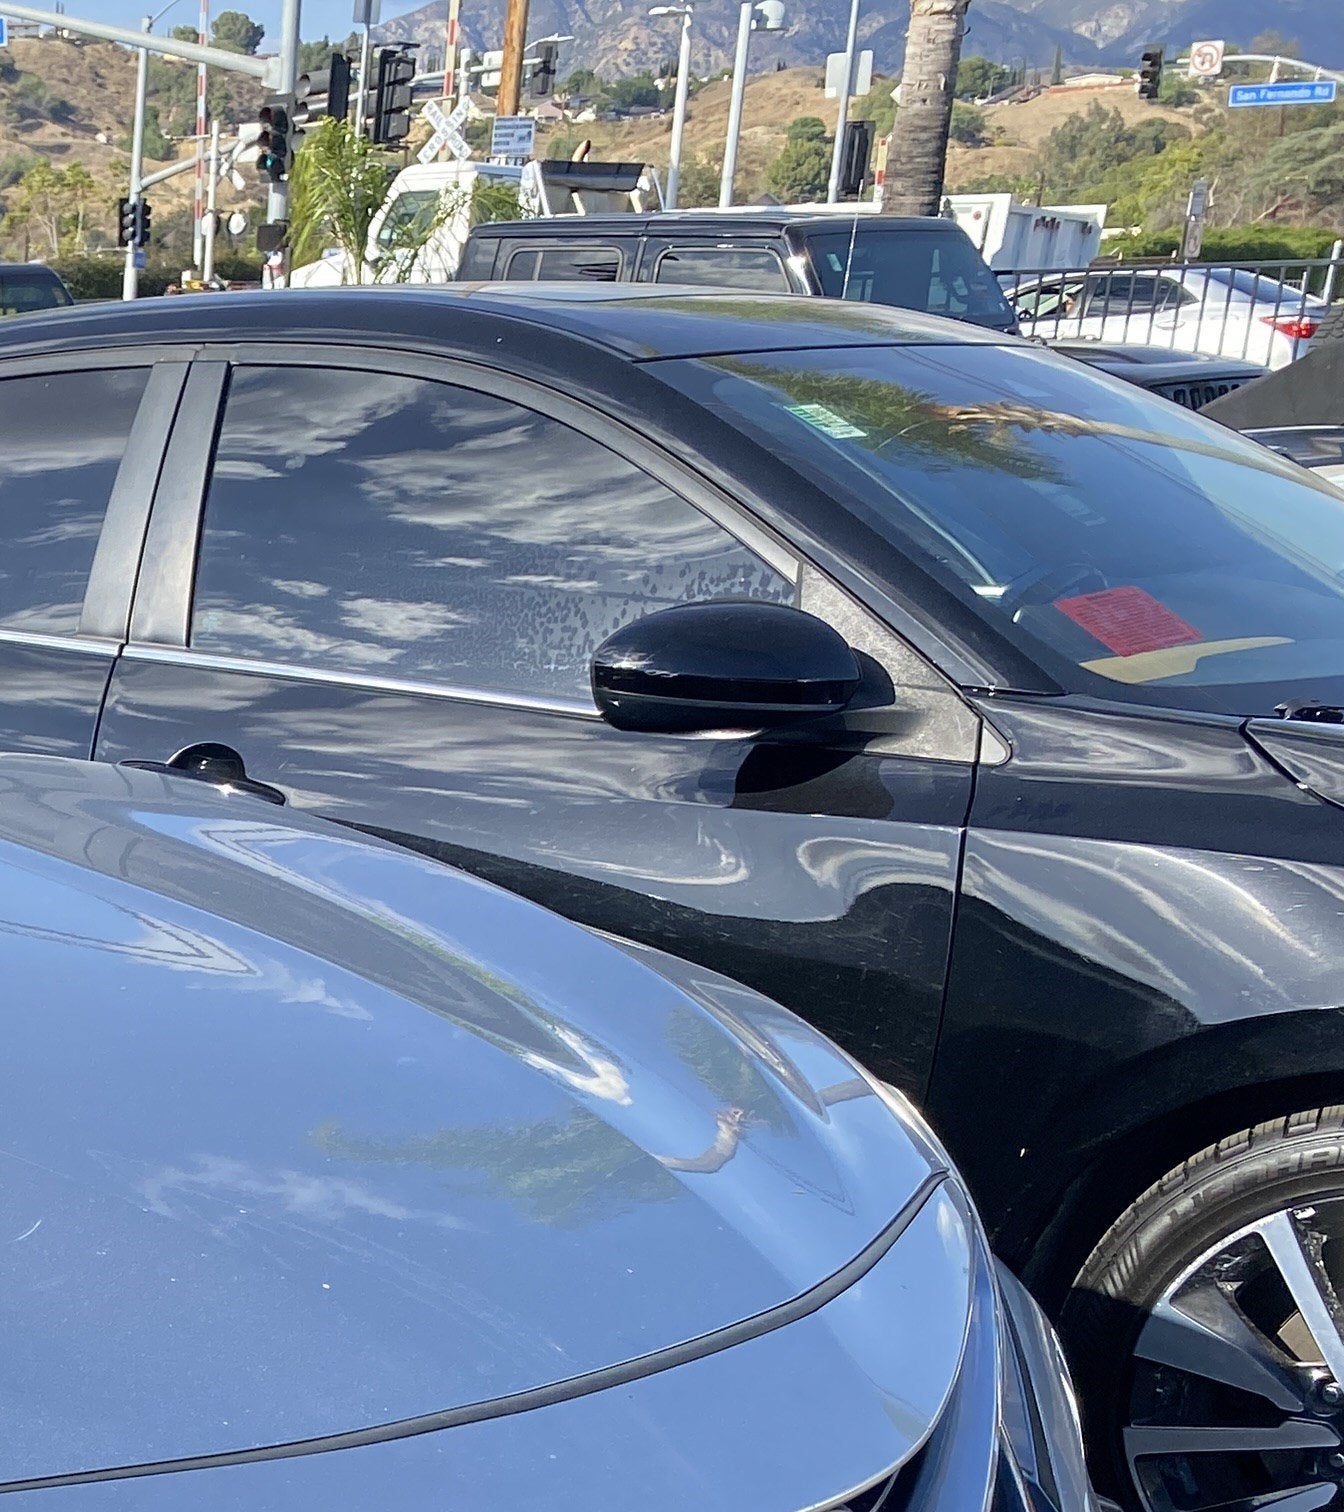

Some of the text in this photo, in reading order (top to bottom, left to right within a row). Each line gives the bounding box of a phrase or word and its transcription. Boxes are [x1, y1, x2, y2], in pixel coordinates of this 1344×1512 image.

[1236, 86, 1330, 101] San Fernando Rd
